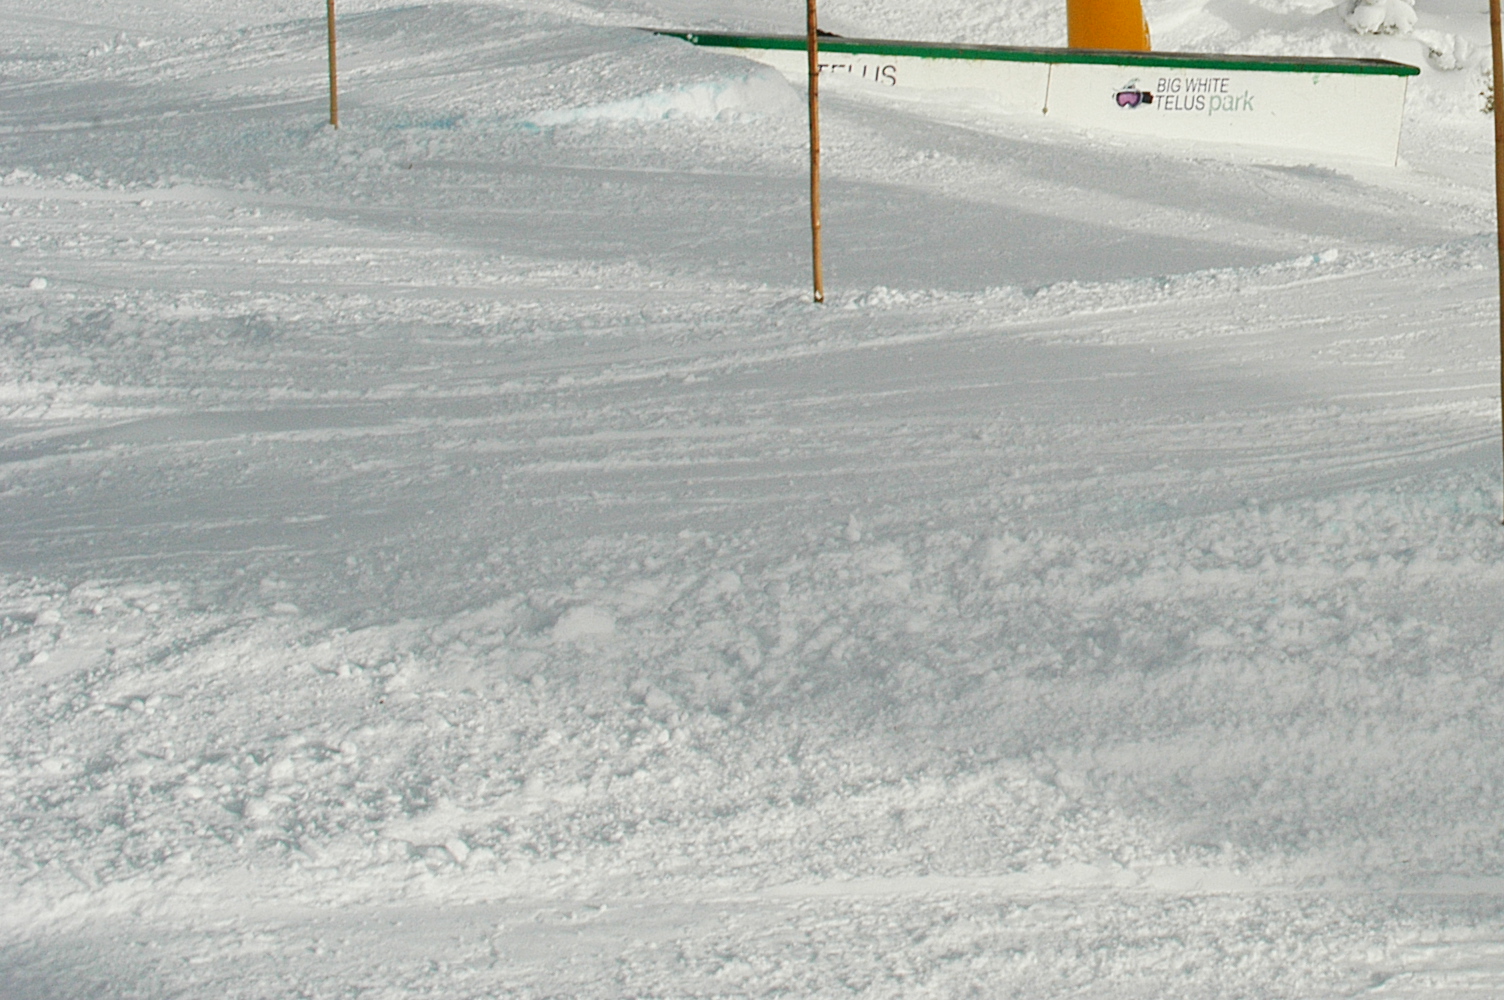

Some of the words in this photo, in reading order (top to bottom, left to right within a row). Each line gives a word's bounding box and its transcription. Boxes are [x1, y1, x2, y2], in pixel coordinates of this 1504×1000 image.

[1157, 77, 1182, 93] BIG
[1185, 77, 1230, 94] WHITE
[1155, 94, 1206, 111] TELUS
[1208, 90, 1255, 117] park
